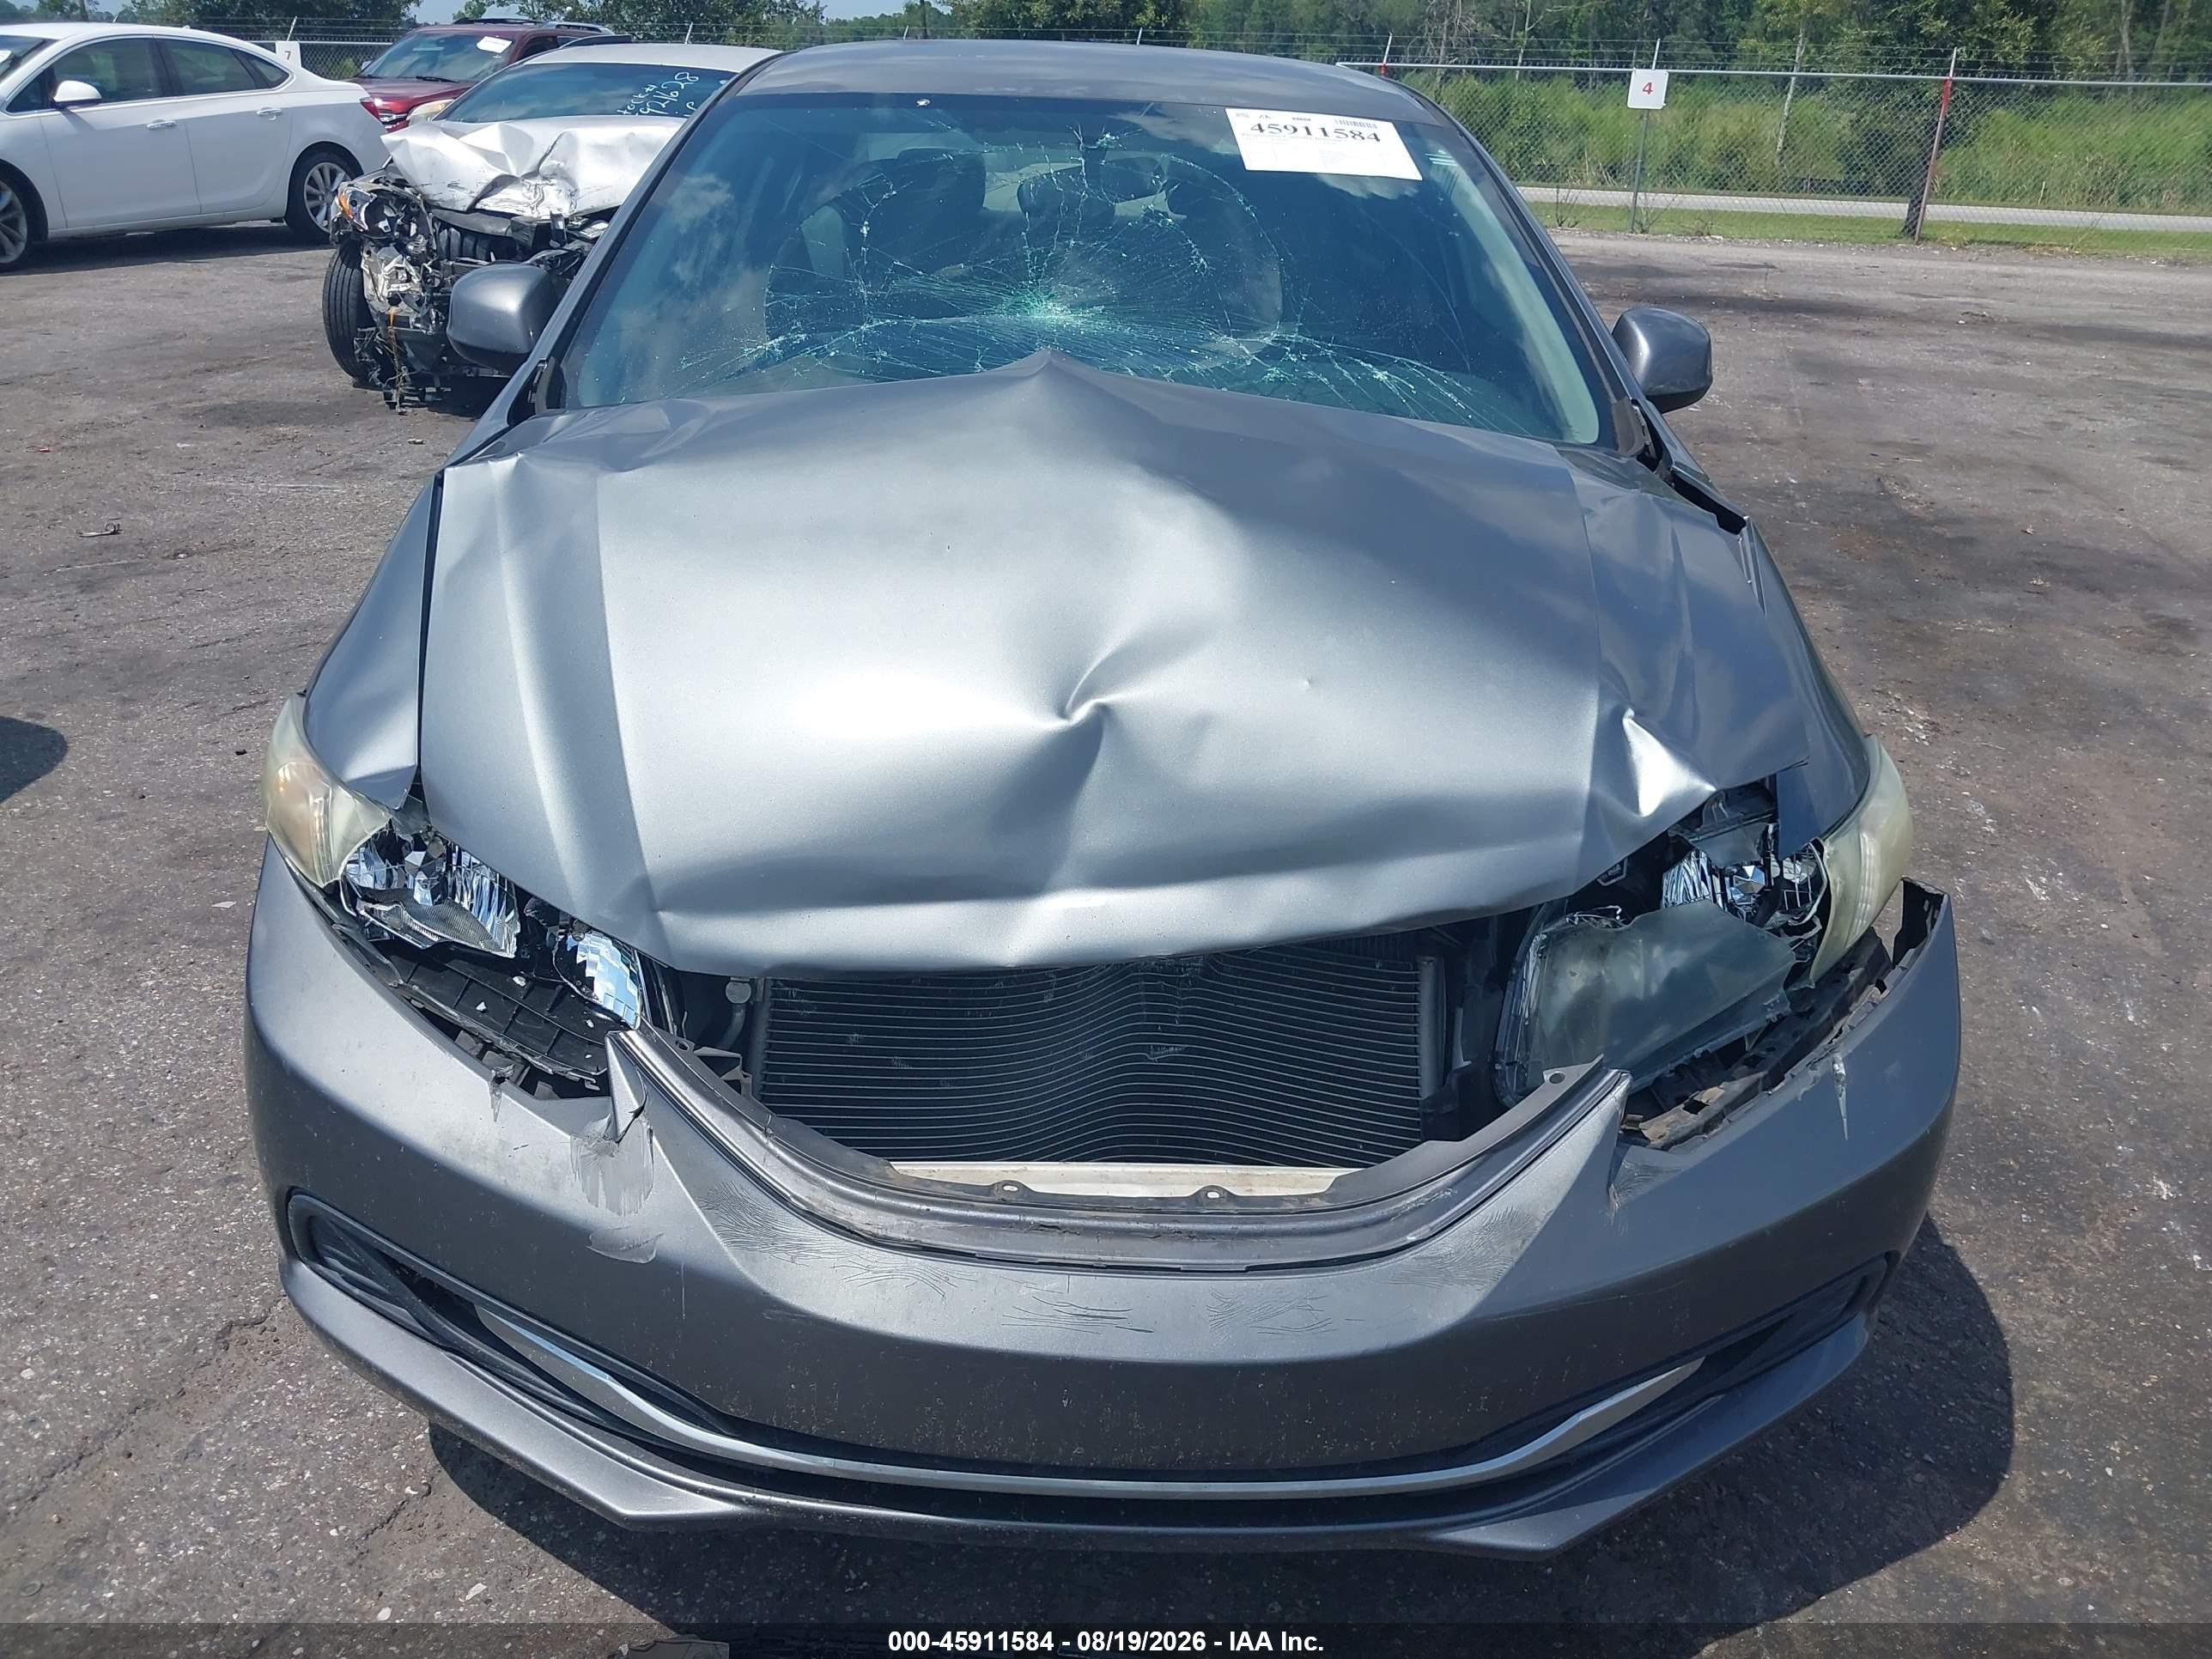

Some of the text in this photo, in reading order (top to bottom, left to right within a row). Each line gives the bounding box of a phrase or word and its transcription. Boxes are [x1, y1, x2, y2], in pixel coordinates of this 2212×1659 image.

[284, 50, 291, 60] 7
[1642, 82, 1654, 95] 4
[1249, 122, 1382, 143] 45911584
